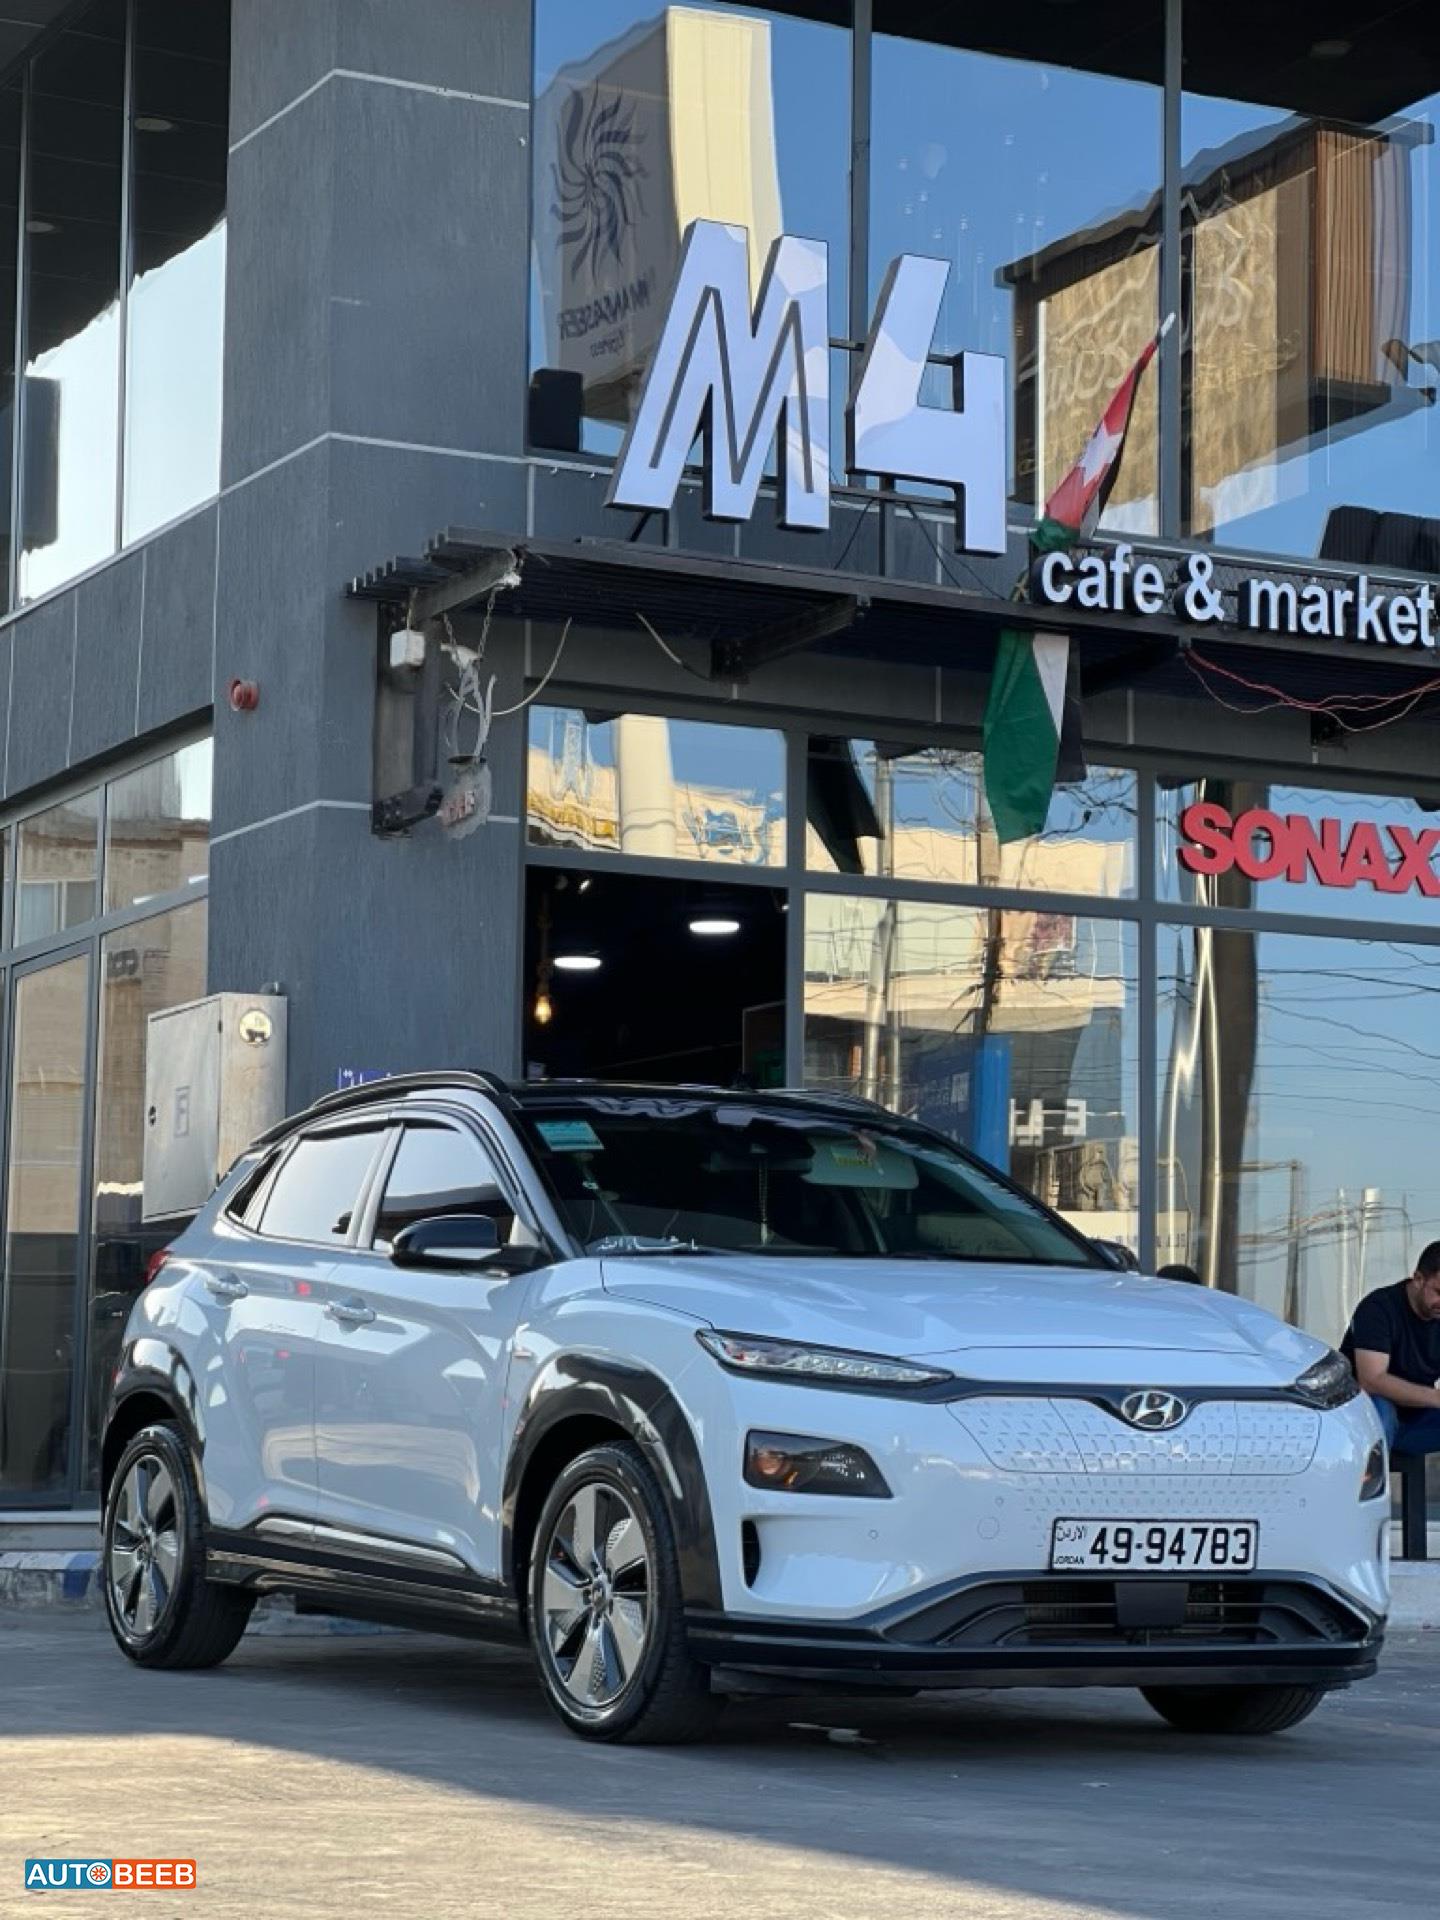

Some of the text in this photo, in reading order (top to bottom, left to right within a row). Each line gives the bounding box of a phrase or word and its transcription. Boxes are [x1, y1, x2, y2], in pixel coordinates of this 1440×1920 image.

[1039, 544, 1437, 648] cafe & market
[1177, 803, 1440, 898] SONAX
[1053, 1555, 1085, 1565] JORDAN
[1089, 1527, 1251, 1565] 49-94783
